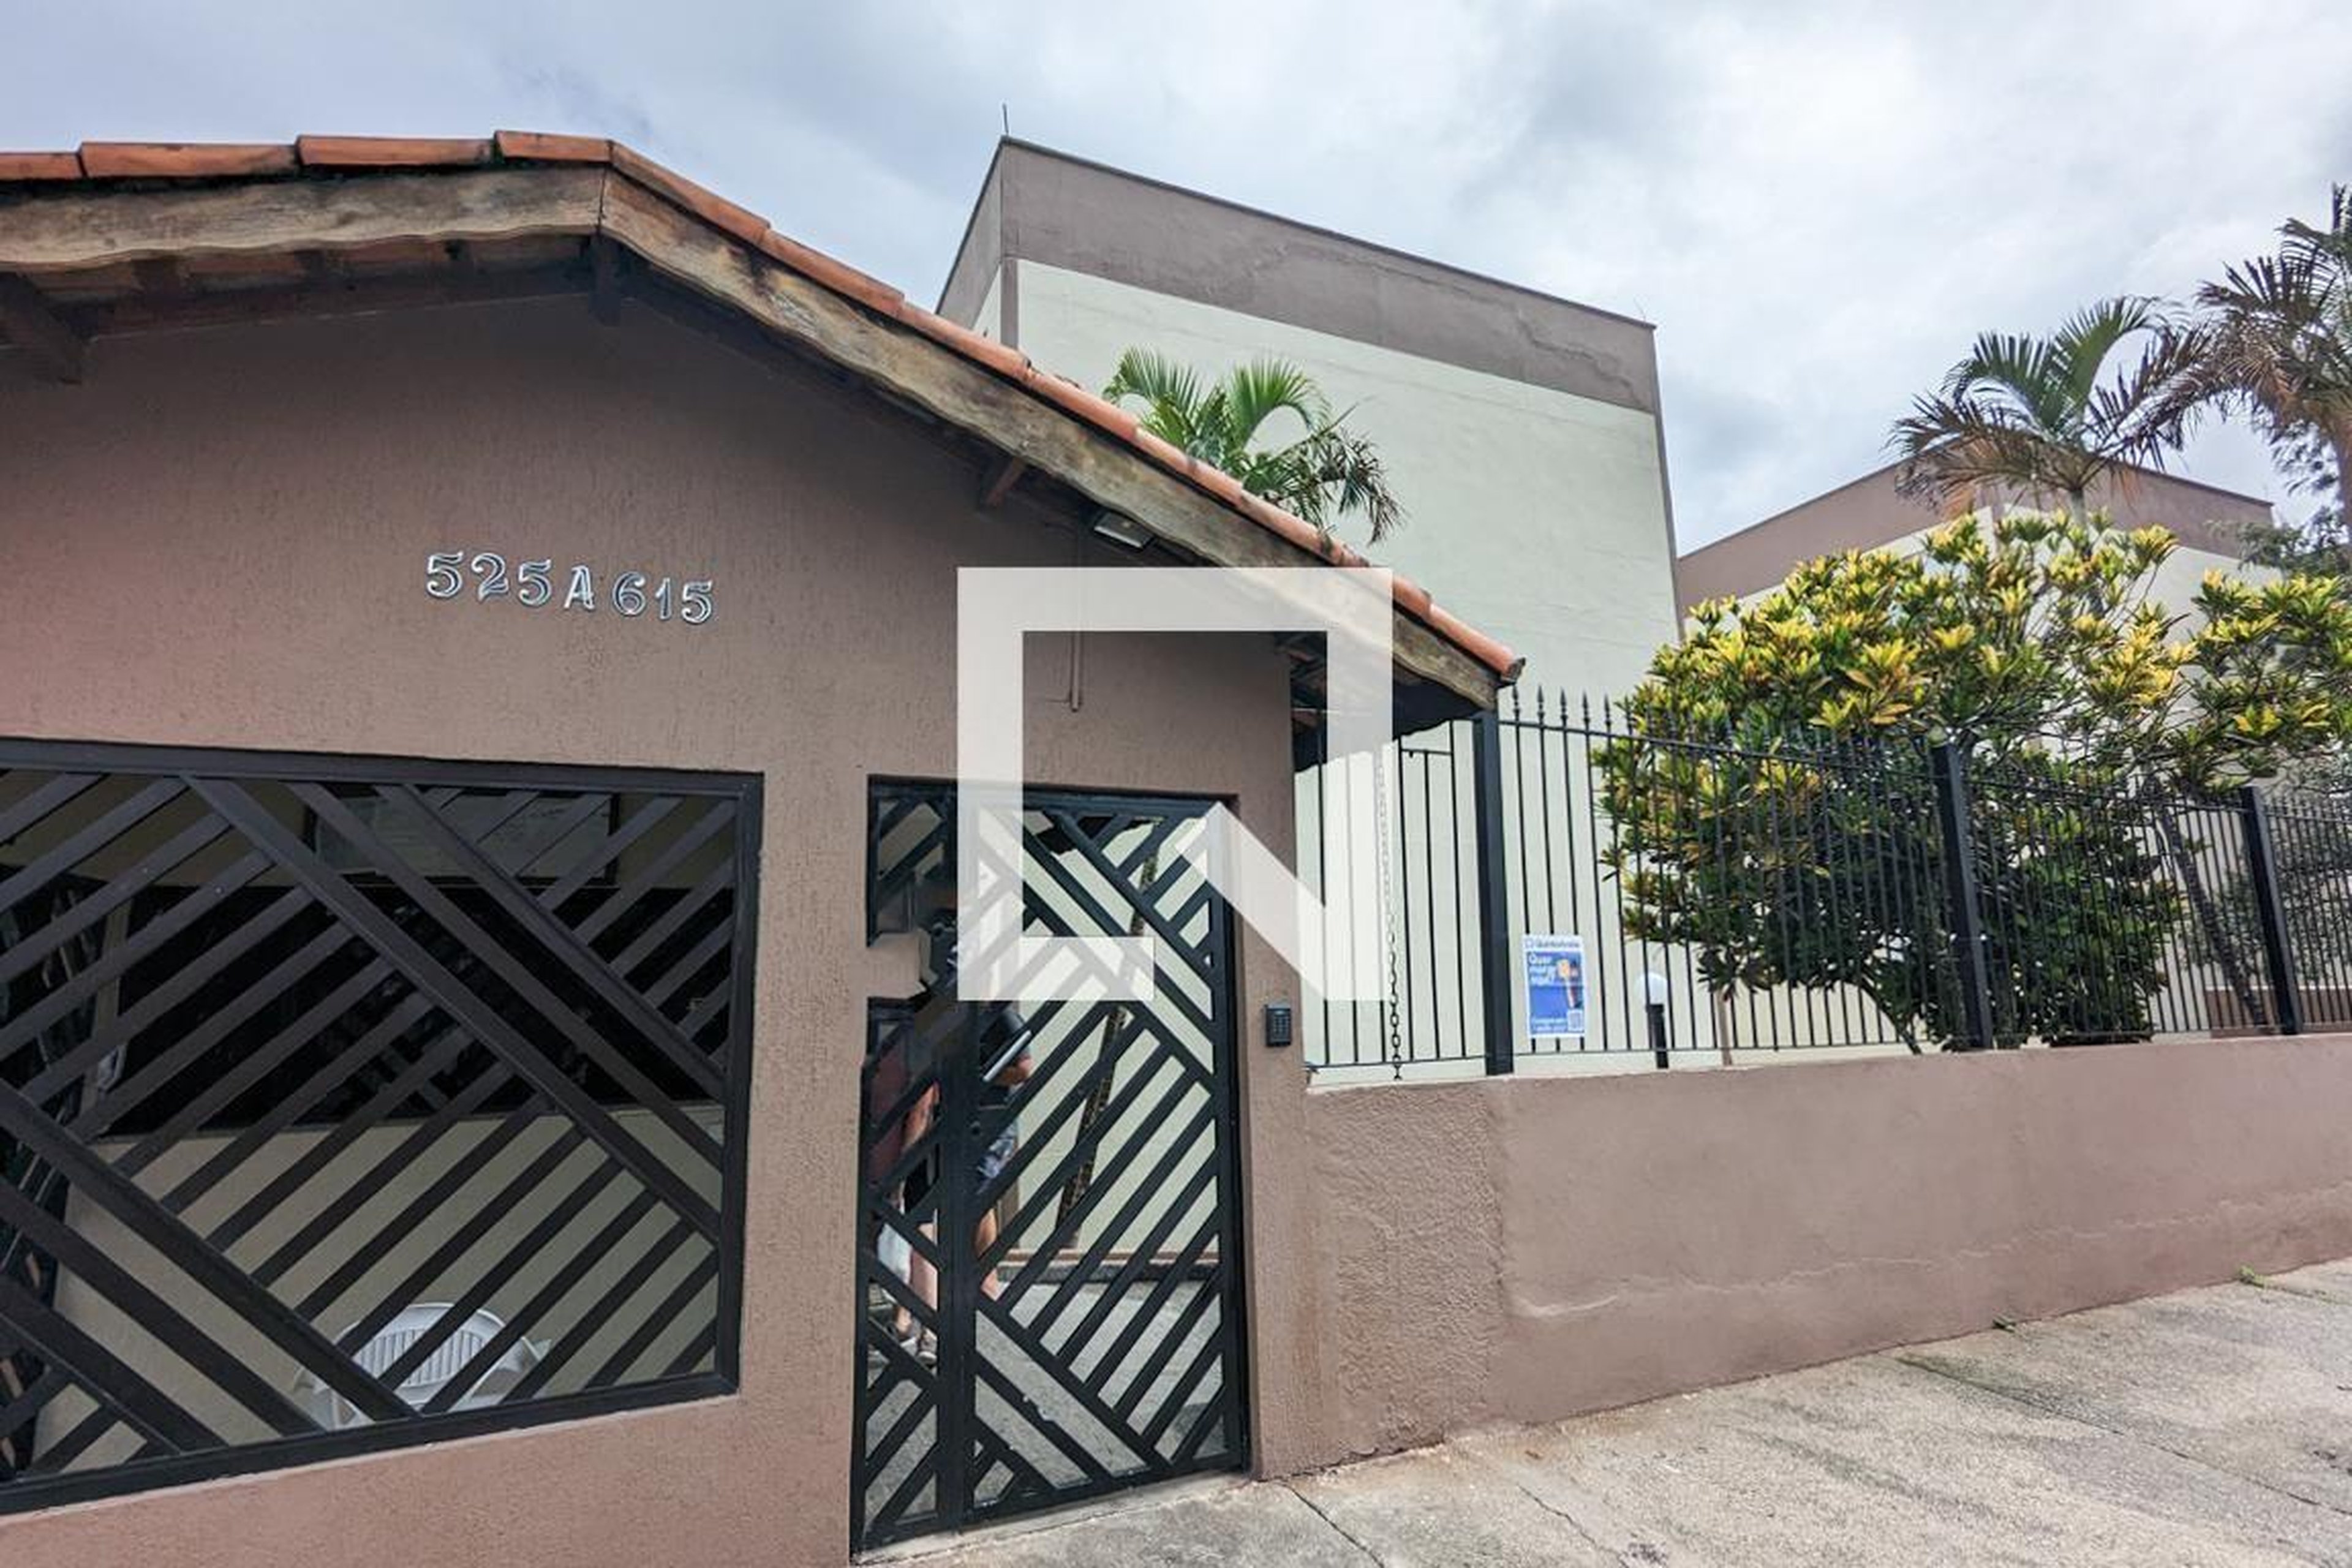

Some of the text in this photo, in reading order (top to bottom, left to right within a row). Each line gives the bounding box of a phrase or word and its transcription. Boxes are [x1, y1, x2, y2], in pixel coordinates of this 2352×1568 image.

[426, 551, 712, 625] 525 A 615
